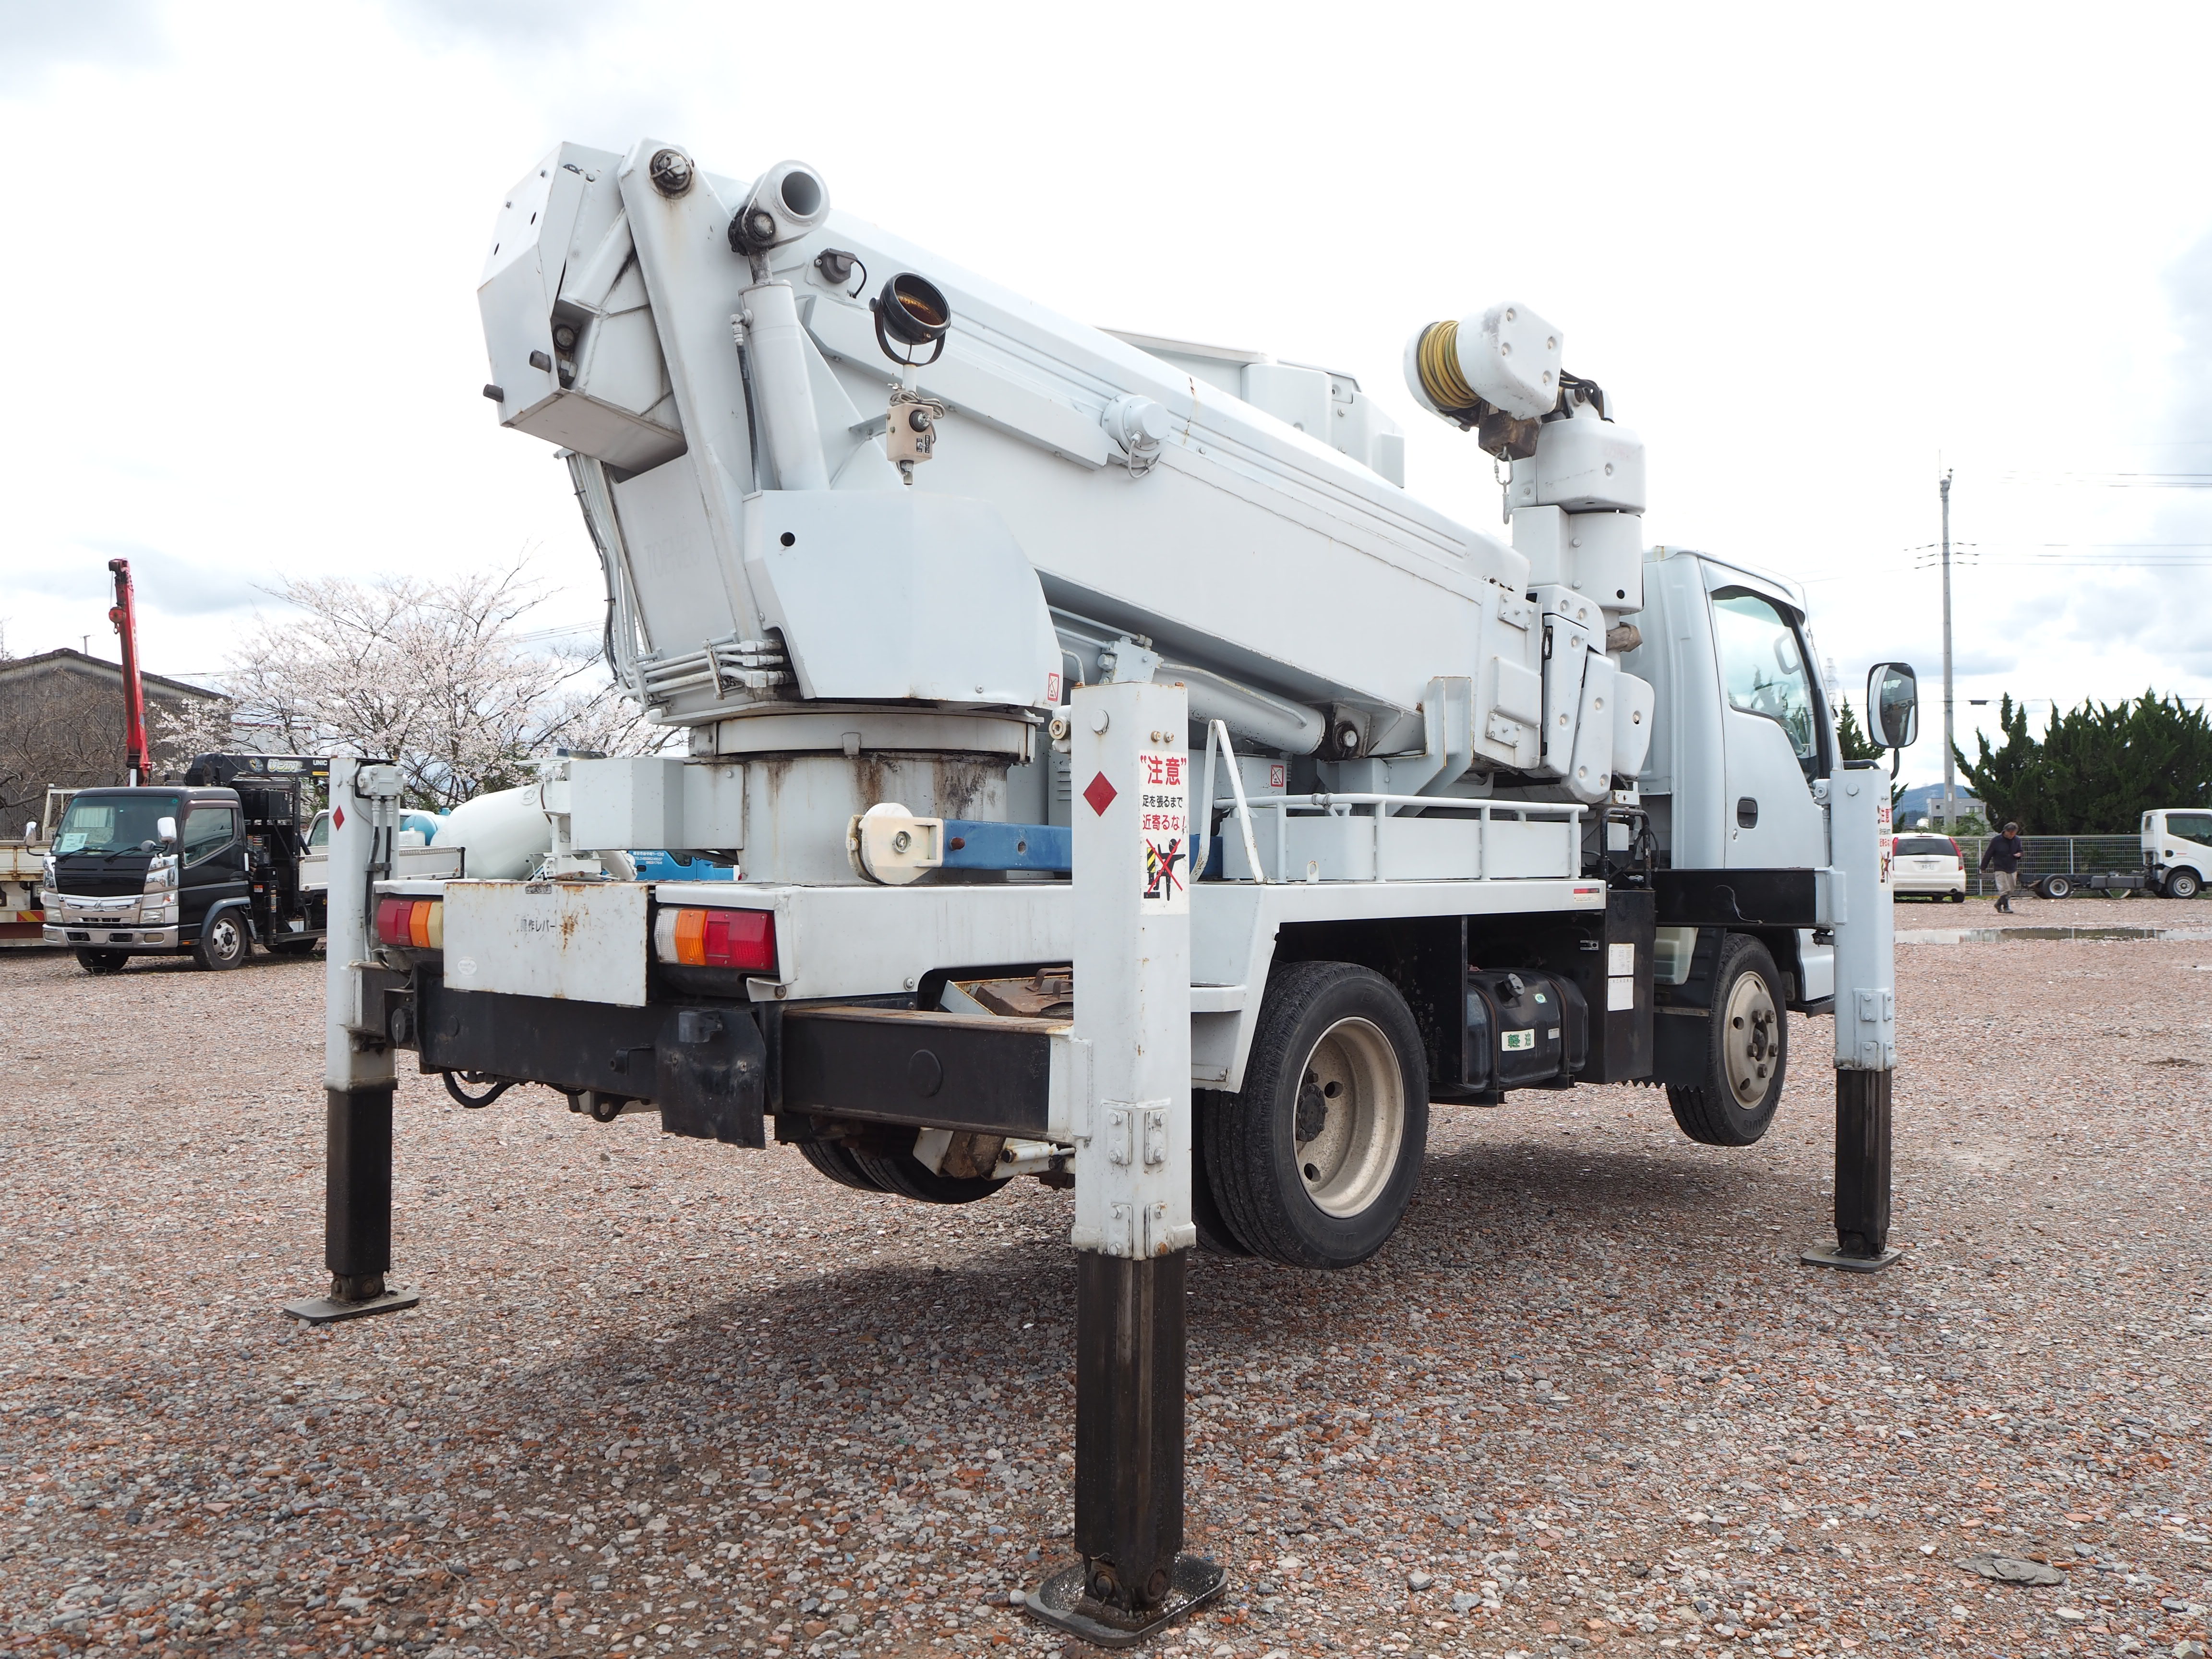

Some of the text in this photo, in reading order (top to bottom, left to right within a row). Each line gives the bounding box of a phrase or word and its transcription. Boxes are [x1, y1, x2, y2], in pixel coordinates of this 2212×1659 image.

[1142, 795, 1183, 808] 足を張るまで
[1507, 1032, 1531, 1048] 軽油
